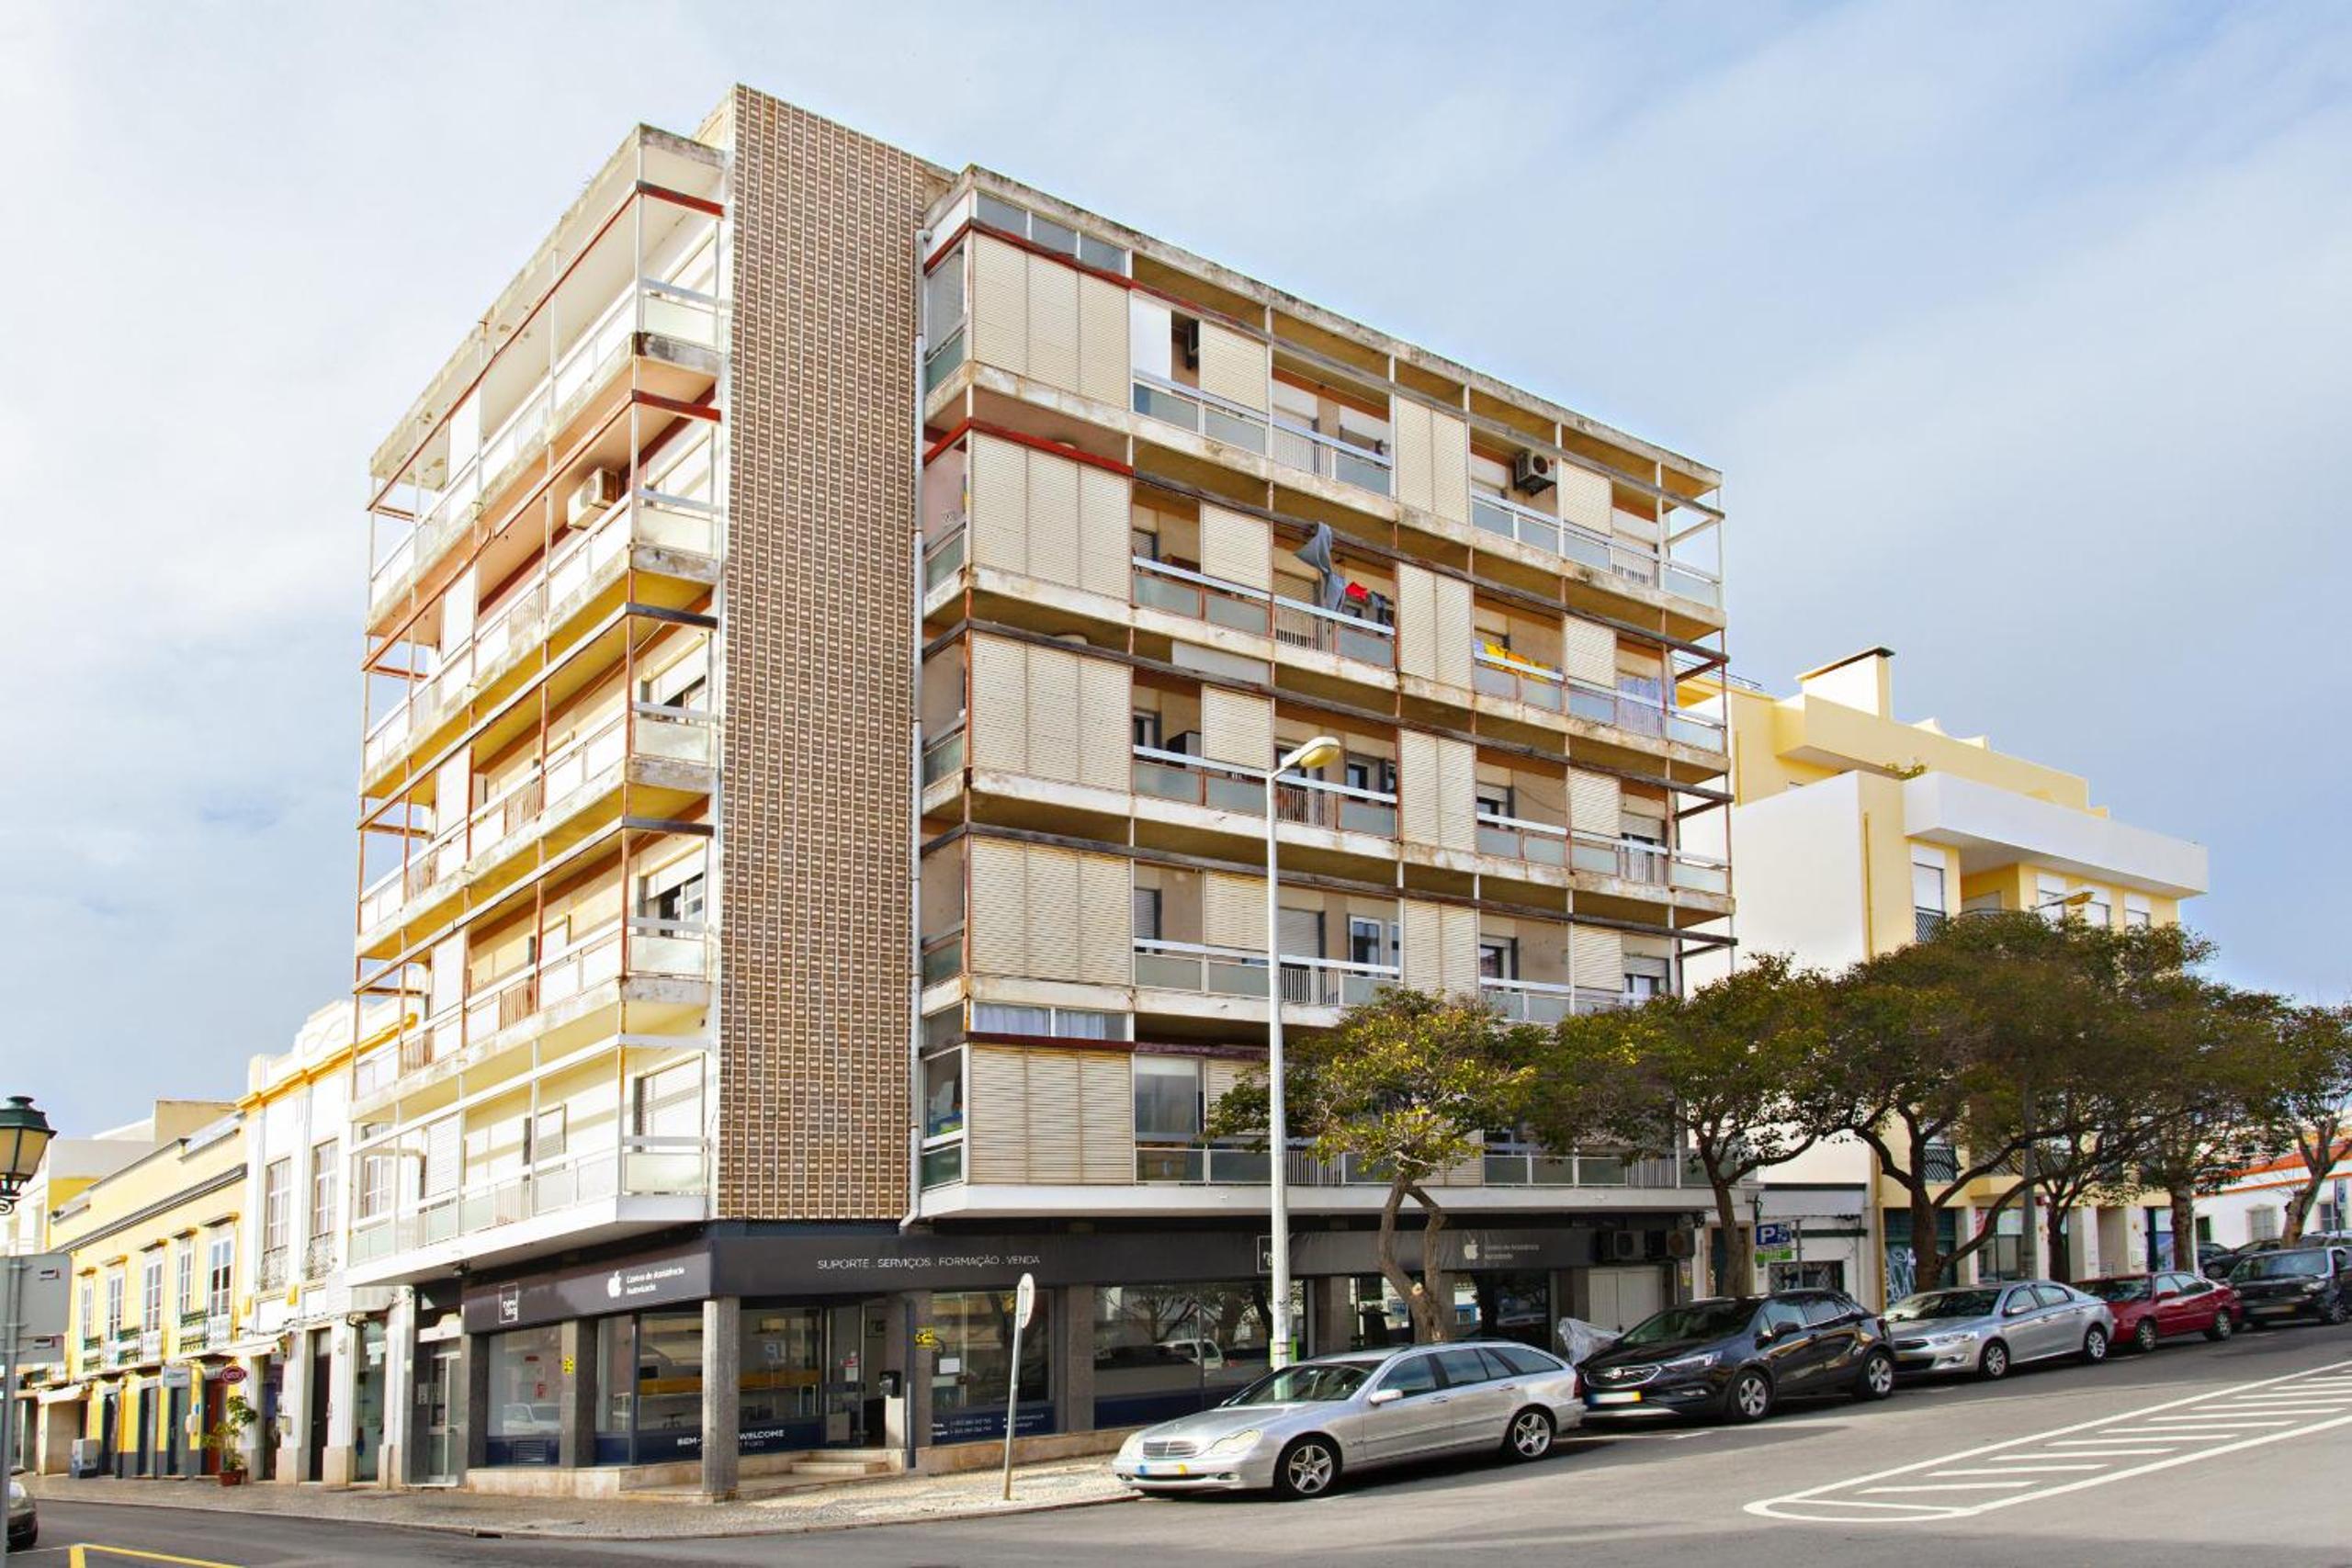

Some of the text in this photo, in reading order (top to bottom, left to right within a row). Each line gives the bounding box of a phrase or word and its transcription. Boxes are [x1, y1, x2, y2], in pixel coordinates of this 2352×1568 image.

[1760, 1227, 1776, 1243] P
[817, 1254, 1041, 1269] SUPORTE SERVIÇOS FORMAÇÃO VENDA
[739, 1429, 785, 1440] WELCOME
